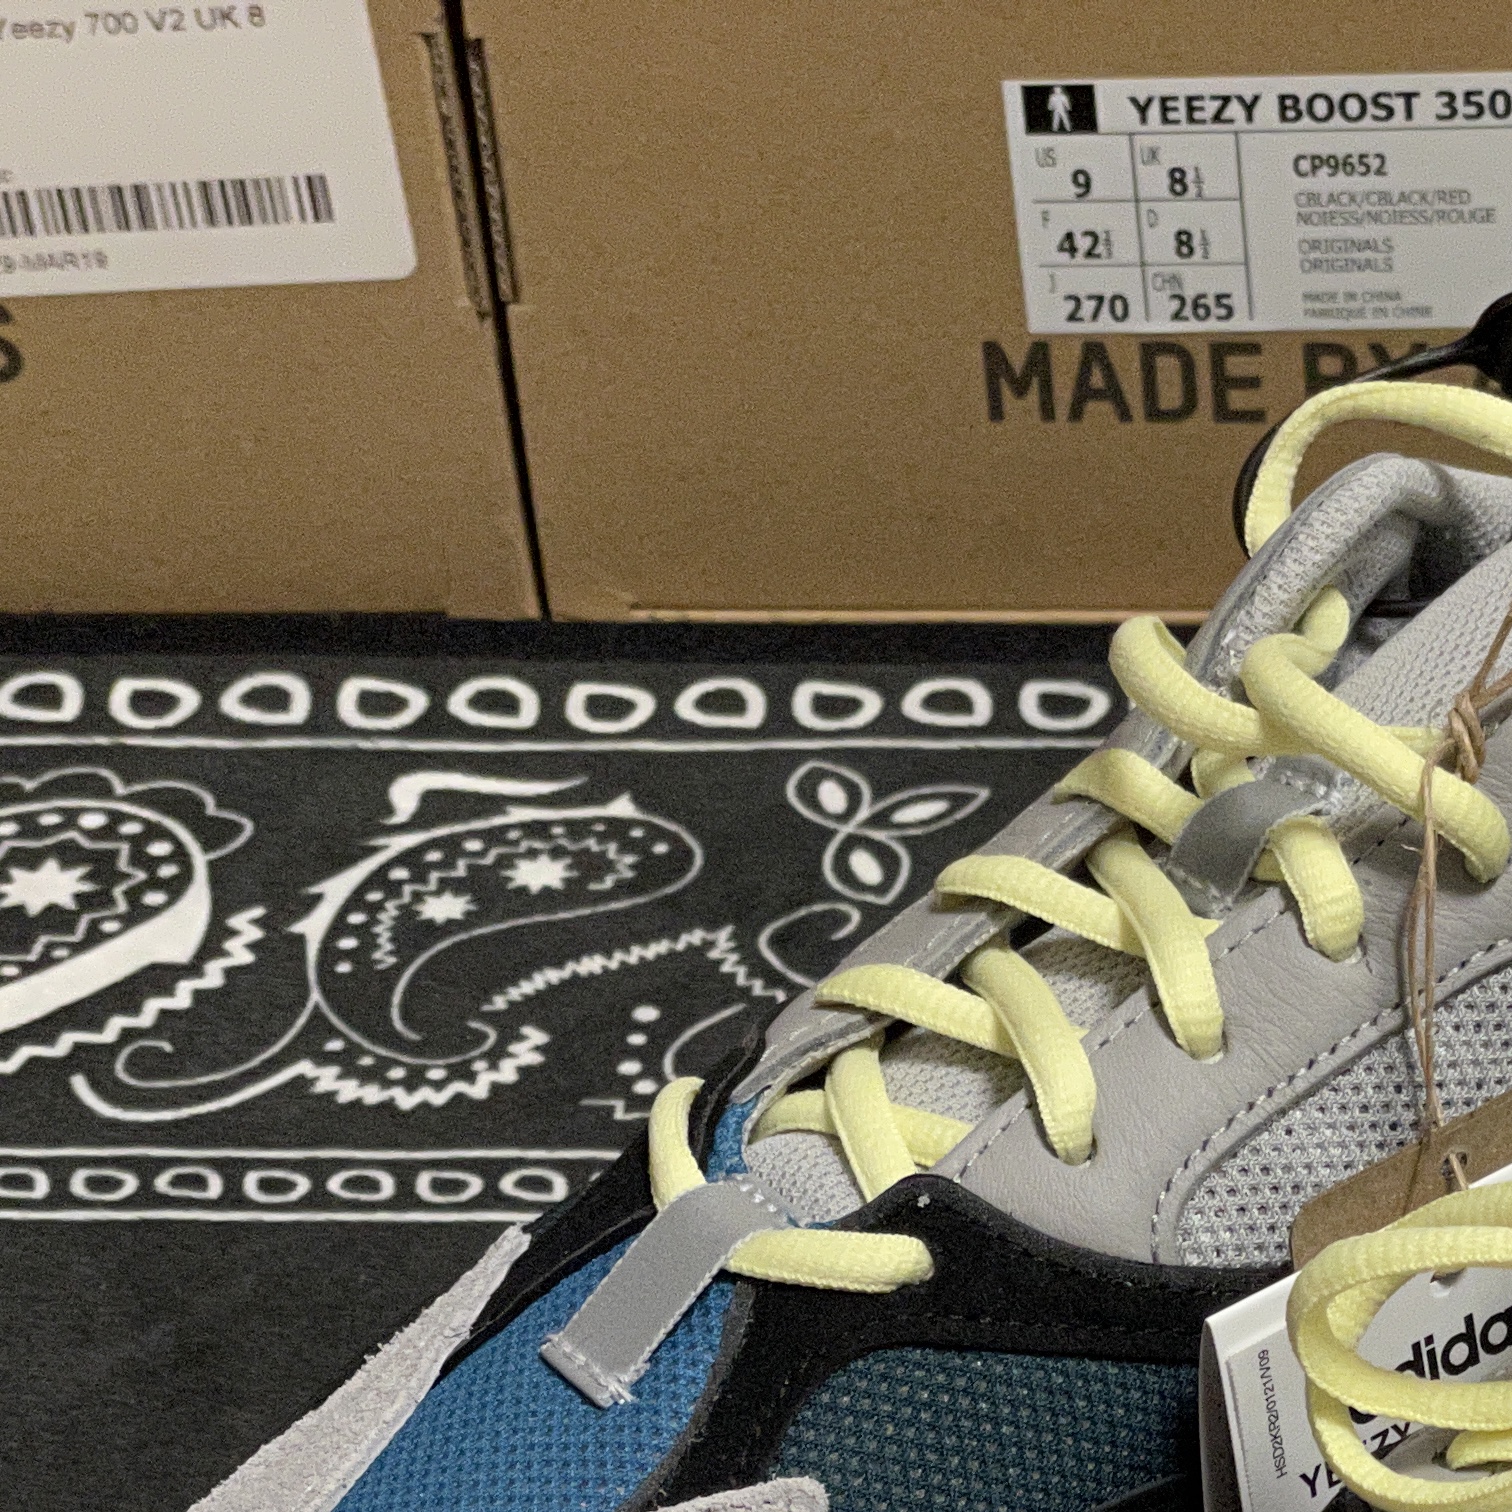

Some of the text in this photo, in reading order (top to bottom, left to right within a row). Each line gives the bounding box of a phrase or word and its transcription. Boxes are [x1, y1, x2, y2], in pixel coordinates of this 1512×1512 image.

[84, 11, 139, 35] 700
[145, 8, 187, 32] V2
[194, 5, 242, 31] UK
[1129, 94, 1263, 125] YEEZY
[1278, 91, 1420, 123] BOOST
[1435, 90, 1512, 121] 350
[1034, 146, 1057, 168] US
[1293, 153, 1389, 178] CP9652
[1071, 168, 1092, 198] 9
[1299, 237, 1395, 255] ORIGINALS
[1300, 256, 1395, 274] ORIGINALS
[1063, 294, 1130, 323] 270
[1168, 293, 1235, 322] 265
[982, 340, 1267, 424] MADE
